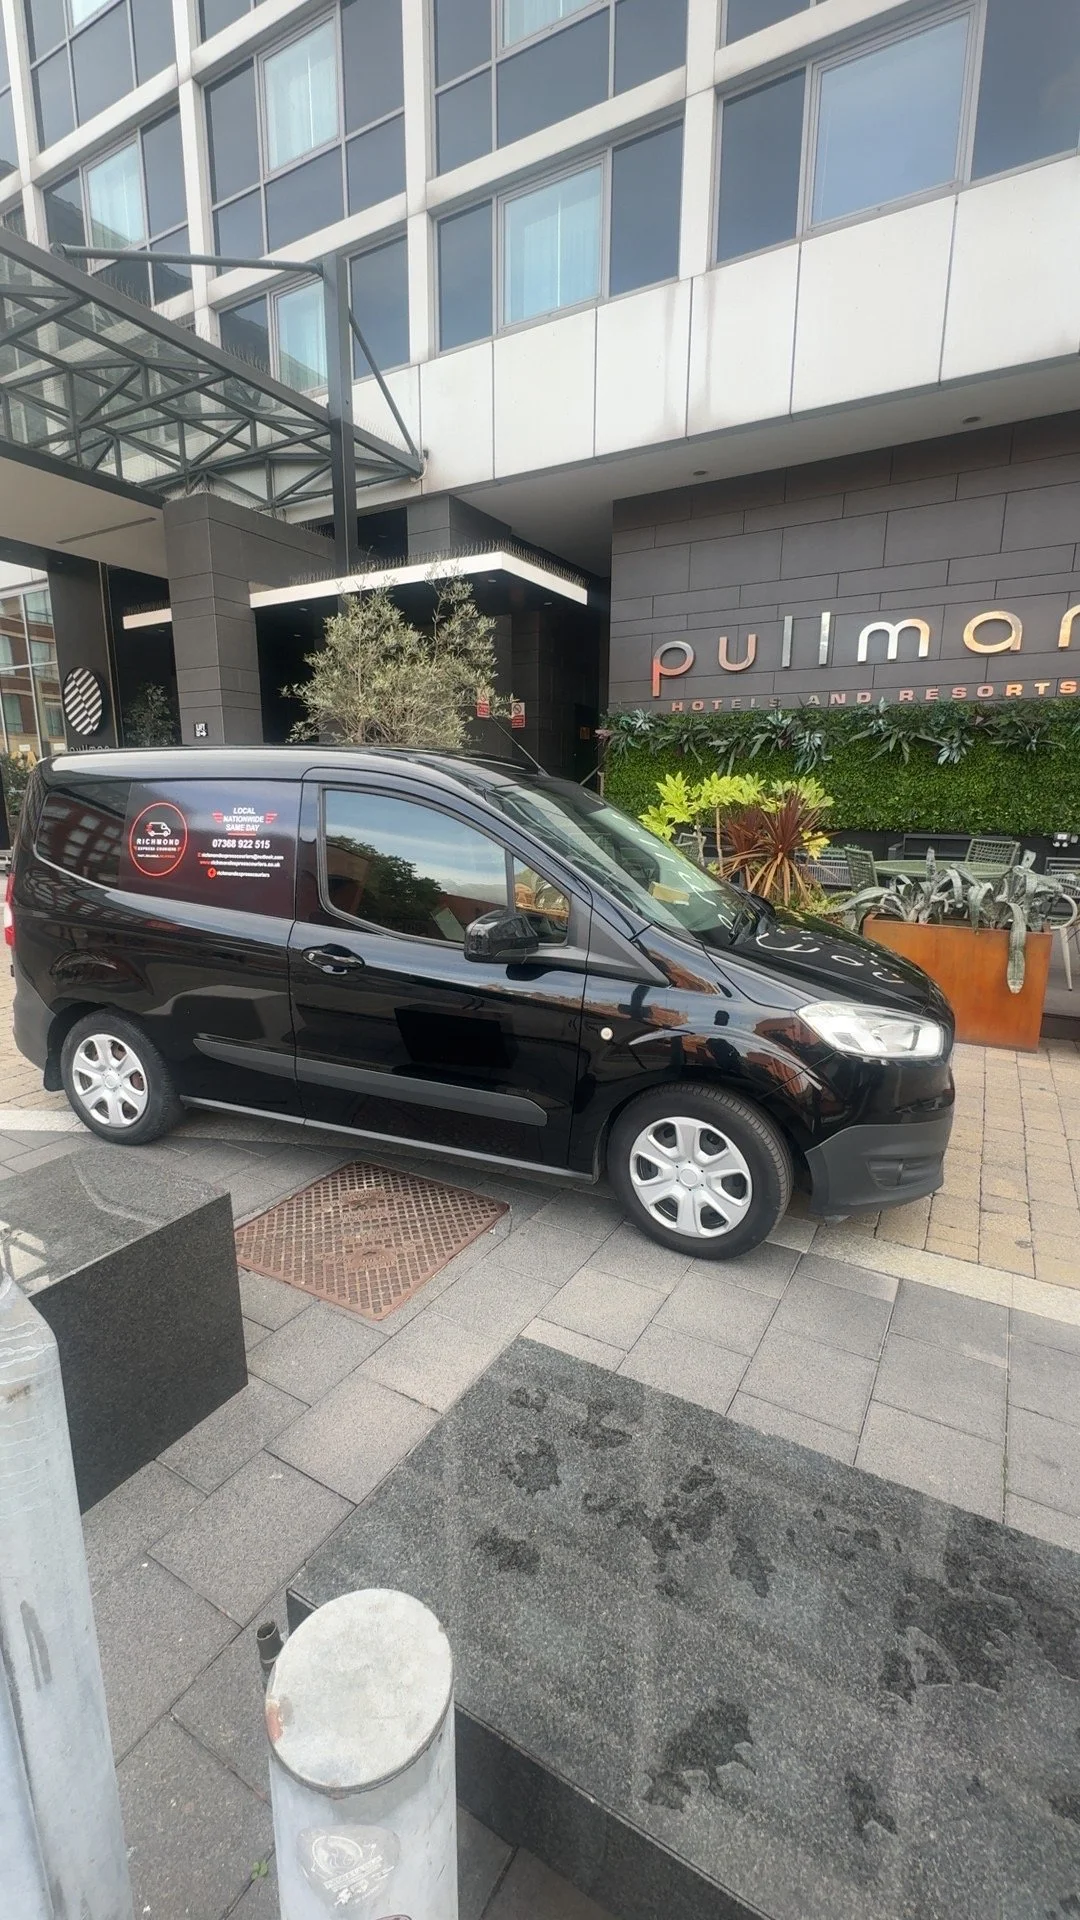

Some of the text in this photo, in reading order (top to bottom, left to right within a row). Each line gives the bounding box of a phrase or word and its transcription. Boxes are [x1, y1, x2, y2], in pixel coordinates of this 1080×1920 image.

[671, 681, 1078, 712] HOTELS AND RESORTS
[233, 807, 256, 815] LOCAL
[223, 815, 265, 823] NATIONWIDE
[225, 823, 260, 832] SAME DAY
[136, 838, 180, 846] RICHMOND
[212, 838, 271, 849] 07368 922 515
